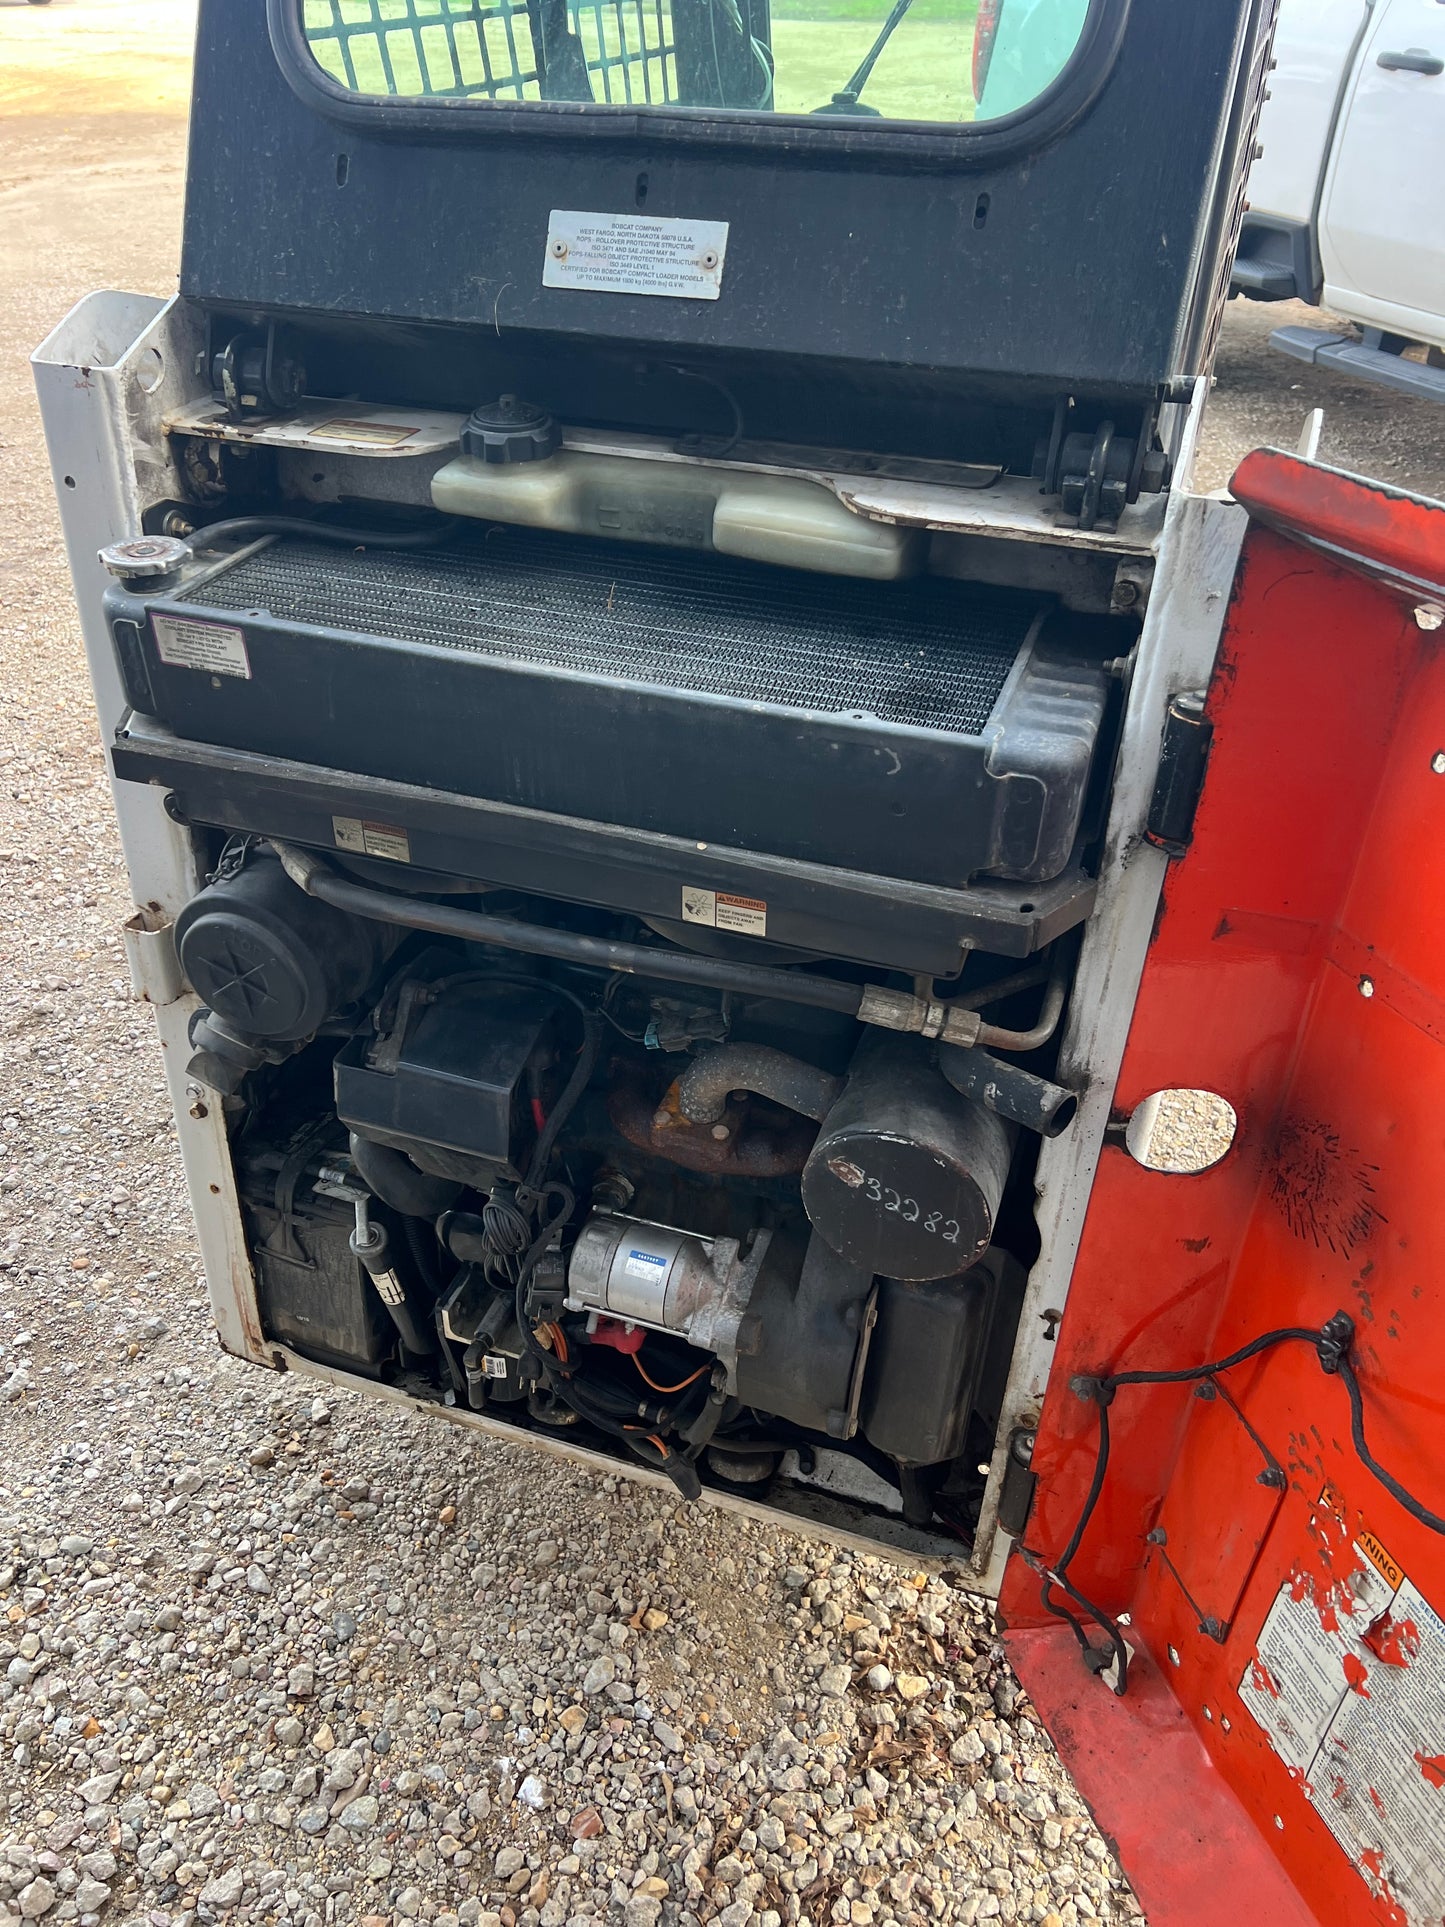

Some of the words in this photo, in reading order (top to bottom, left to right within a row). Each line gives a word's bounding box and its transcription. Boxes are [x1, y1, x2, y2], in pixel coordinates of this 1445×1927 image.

[626, 239, 660, 247] PROTECTIVE
[661, 242, 695, 250] STRUCTURE
[630, 255, 664, 263] PROTECTIVE
[665, 258, 699, 266] STRUCTURE
[560, 265, 588, 273] CERTIFIED
[627, 270, 654, 278] COMPACT
[655, 272, 679, 280] LOADER
[679, 274, 704, 282] MODELS
[593, 275, 620, 283] MAXIMUM
[725, 895, 764, 909] WARNING
[866, 1177, 961, 1244] 32282
[1366, 1568, 1387, 1595] DEATH
[1419, 1600, 1445, 1638] SERVI
